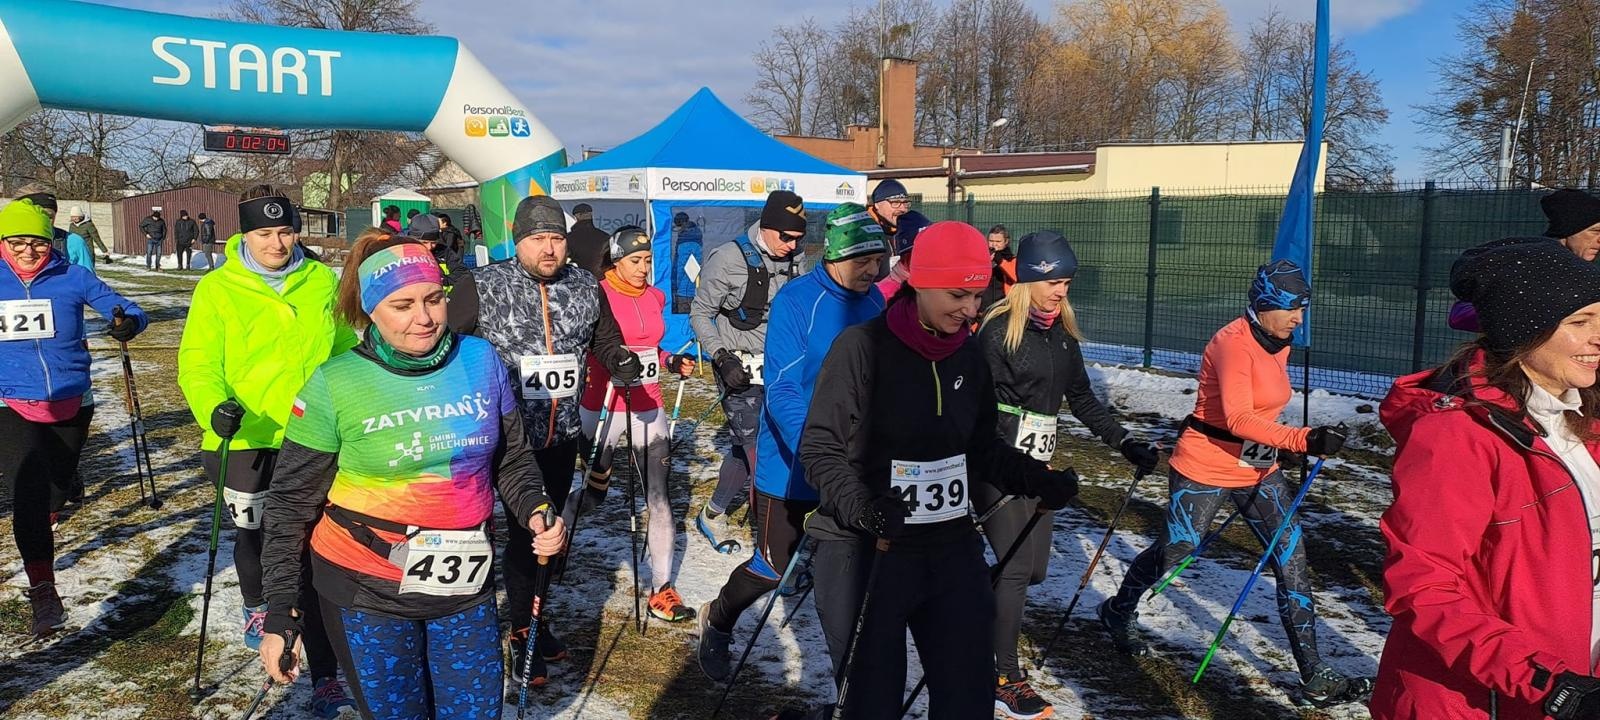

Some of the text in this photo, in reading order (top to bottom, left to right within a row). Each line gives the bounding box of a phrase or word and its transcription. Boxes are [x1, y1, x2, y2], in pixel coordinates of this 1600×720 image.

[152, 36, 342, 97] START
[463, 103, 525, 117] PersonalBest
[662, 176, 745, 192] PersonalBest
[836, 188, 855, 197] MITKO
[525, 369, 576, 391] 405
[430, 435, 489, 452] PILCHOWICE
[1020, 432, 1056, 454] 438
[901, 479, 964, 512] 439
[407, 554, 488, 584] 437
